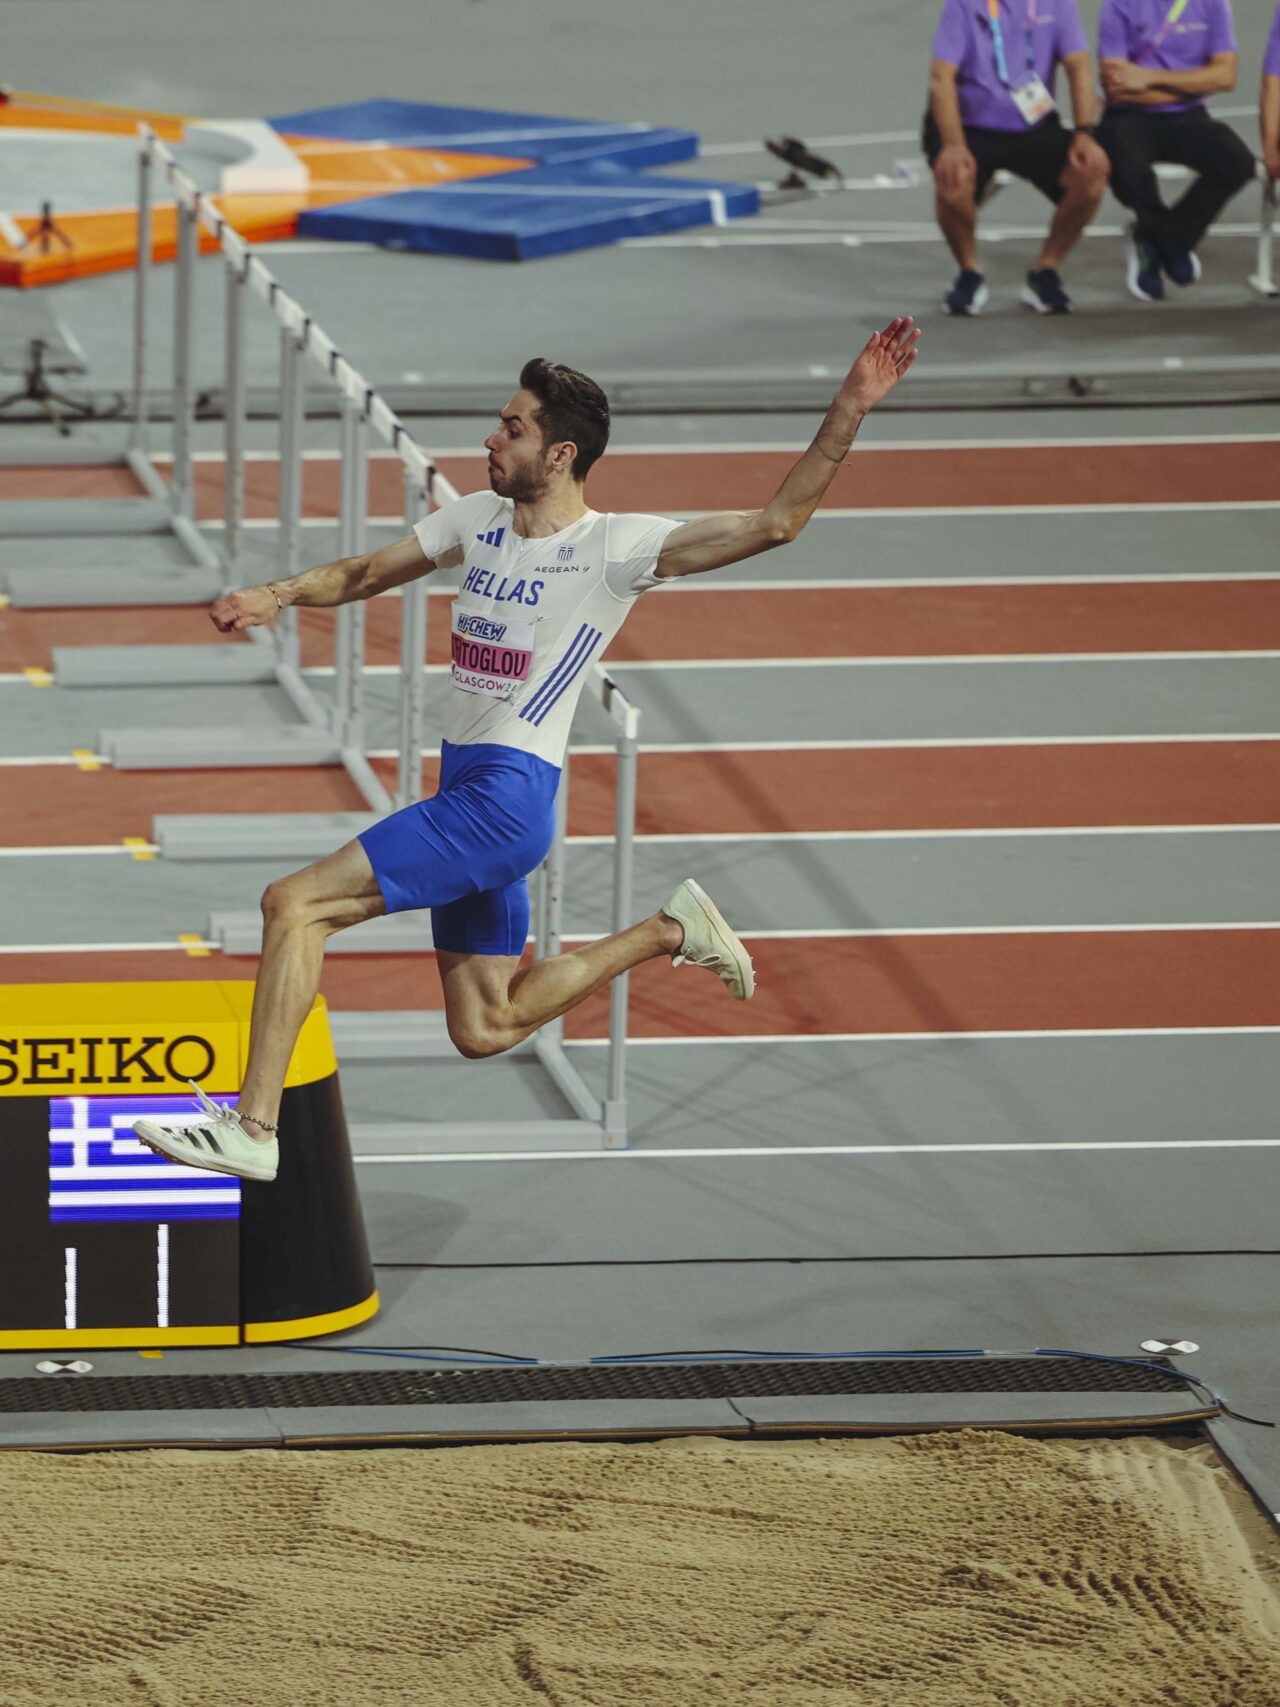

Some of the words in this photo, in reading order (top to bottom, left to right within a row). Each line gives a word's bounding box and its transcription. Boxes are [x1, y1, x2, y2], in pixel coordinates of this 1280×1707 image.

[534, 565, 580, 574] AEGEAN
[463, 566, 545, 606] HELLAS
[457, 613, 507, 641] HI-CHEW
